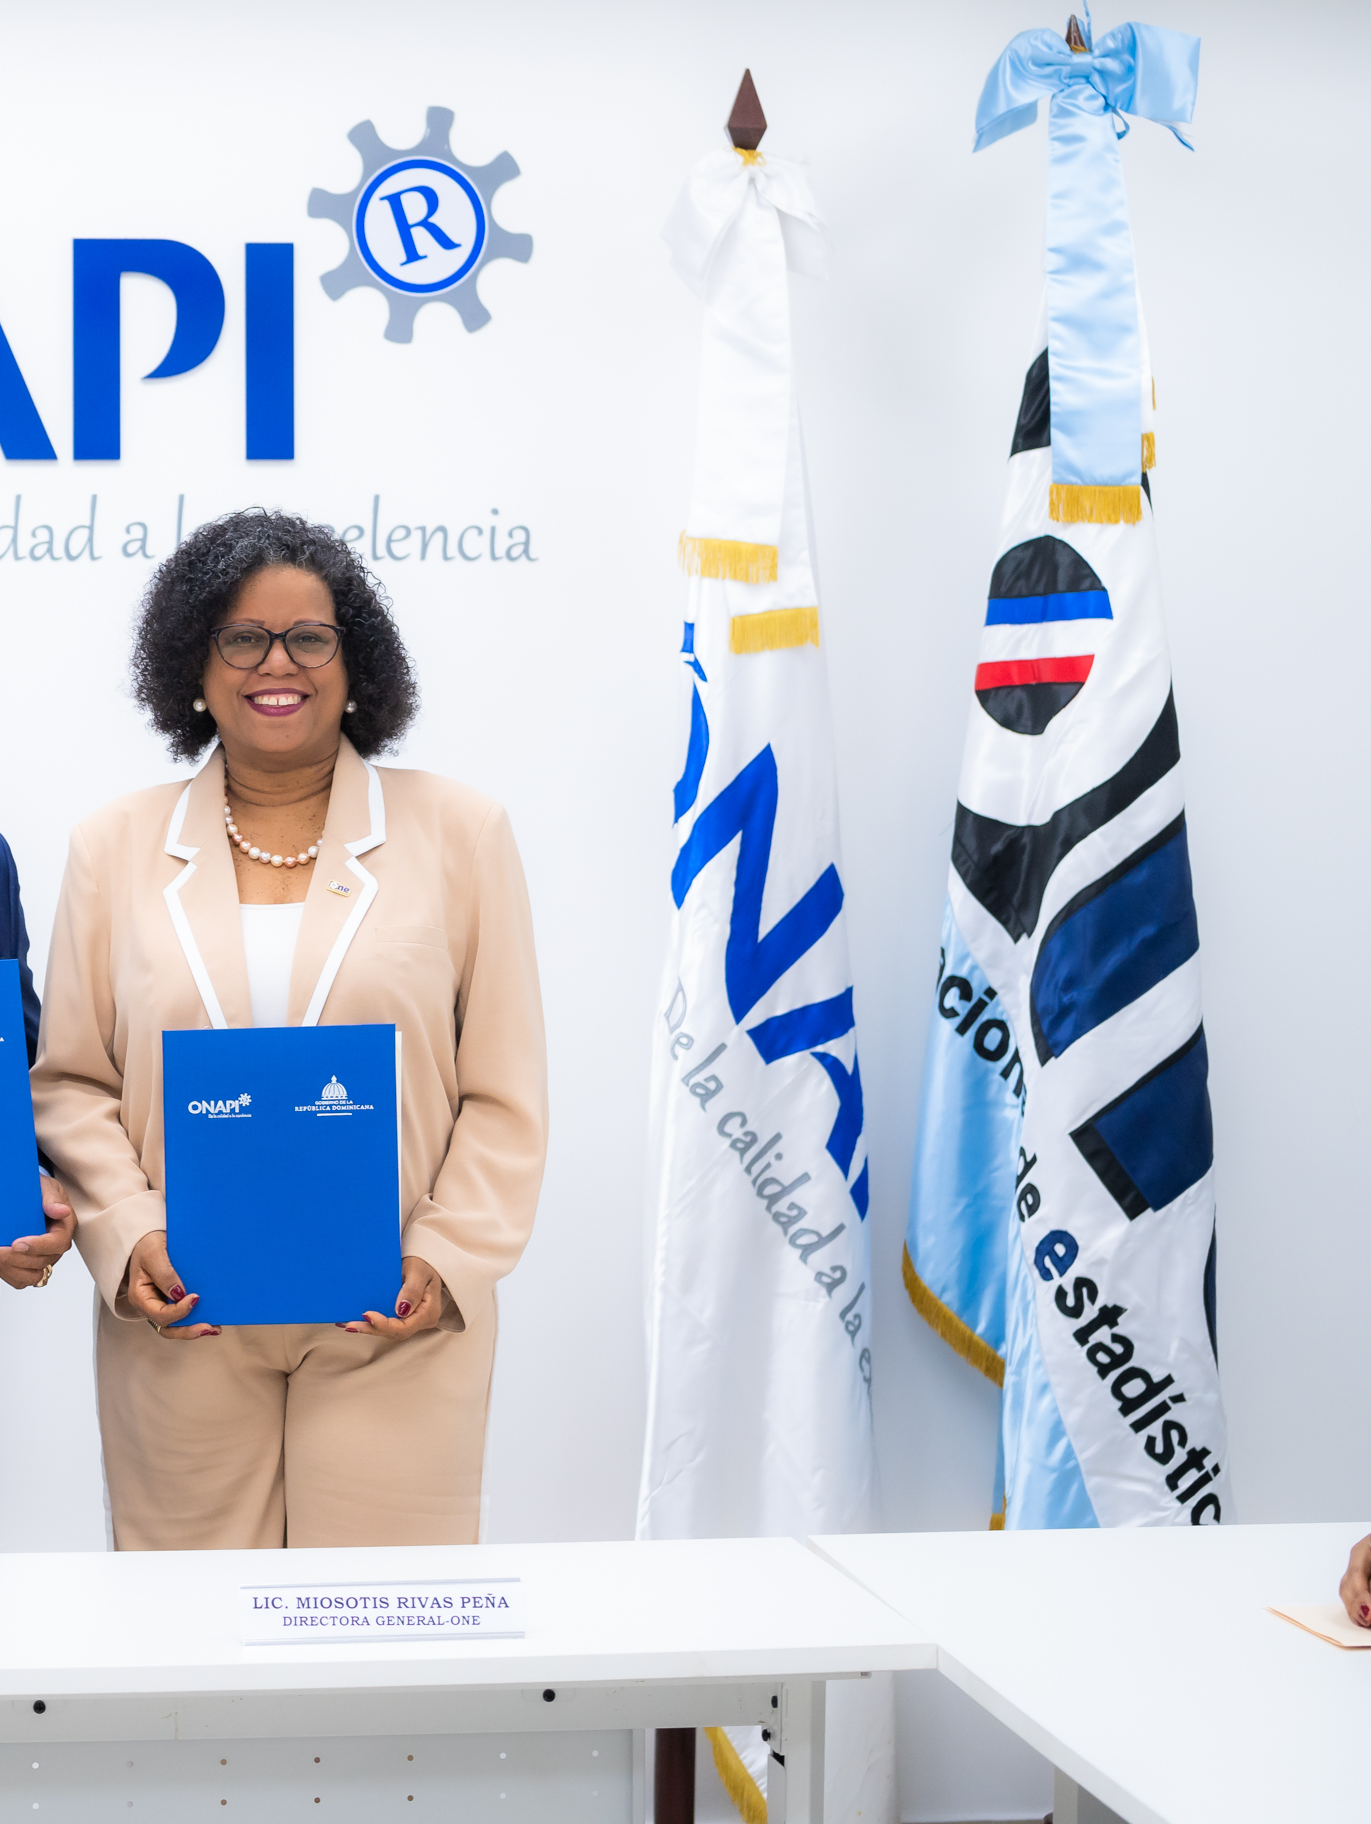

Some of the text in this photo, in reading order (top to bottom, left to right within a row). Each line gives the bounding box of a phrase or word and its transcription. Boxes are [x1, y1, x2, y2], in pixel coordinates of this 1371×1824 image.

[379, 185, 462, 266] R
[121, 520, 155, 559] a
[318, 494, 539, 562] elencia
[936, 947, 1027, 1118] cion
[188, 1100, 240, 1114] ONAPI
[664, 976, 695, 1061] De
[681, 1042, 728, 1113] la
[716, 1111, 847, 1265] calidad
[814, 1265, 847, 1300] a
[839, 1282, 866, 1348] la
[252, 1593, 510, 1609] LIC. MIOSOTIS RIVAS PEÑA
[283, 1615, 481, 1627] DIRECTORA GENERAL-ONE
